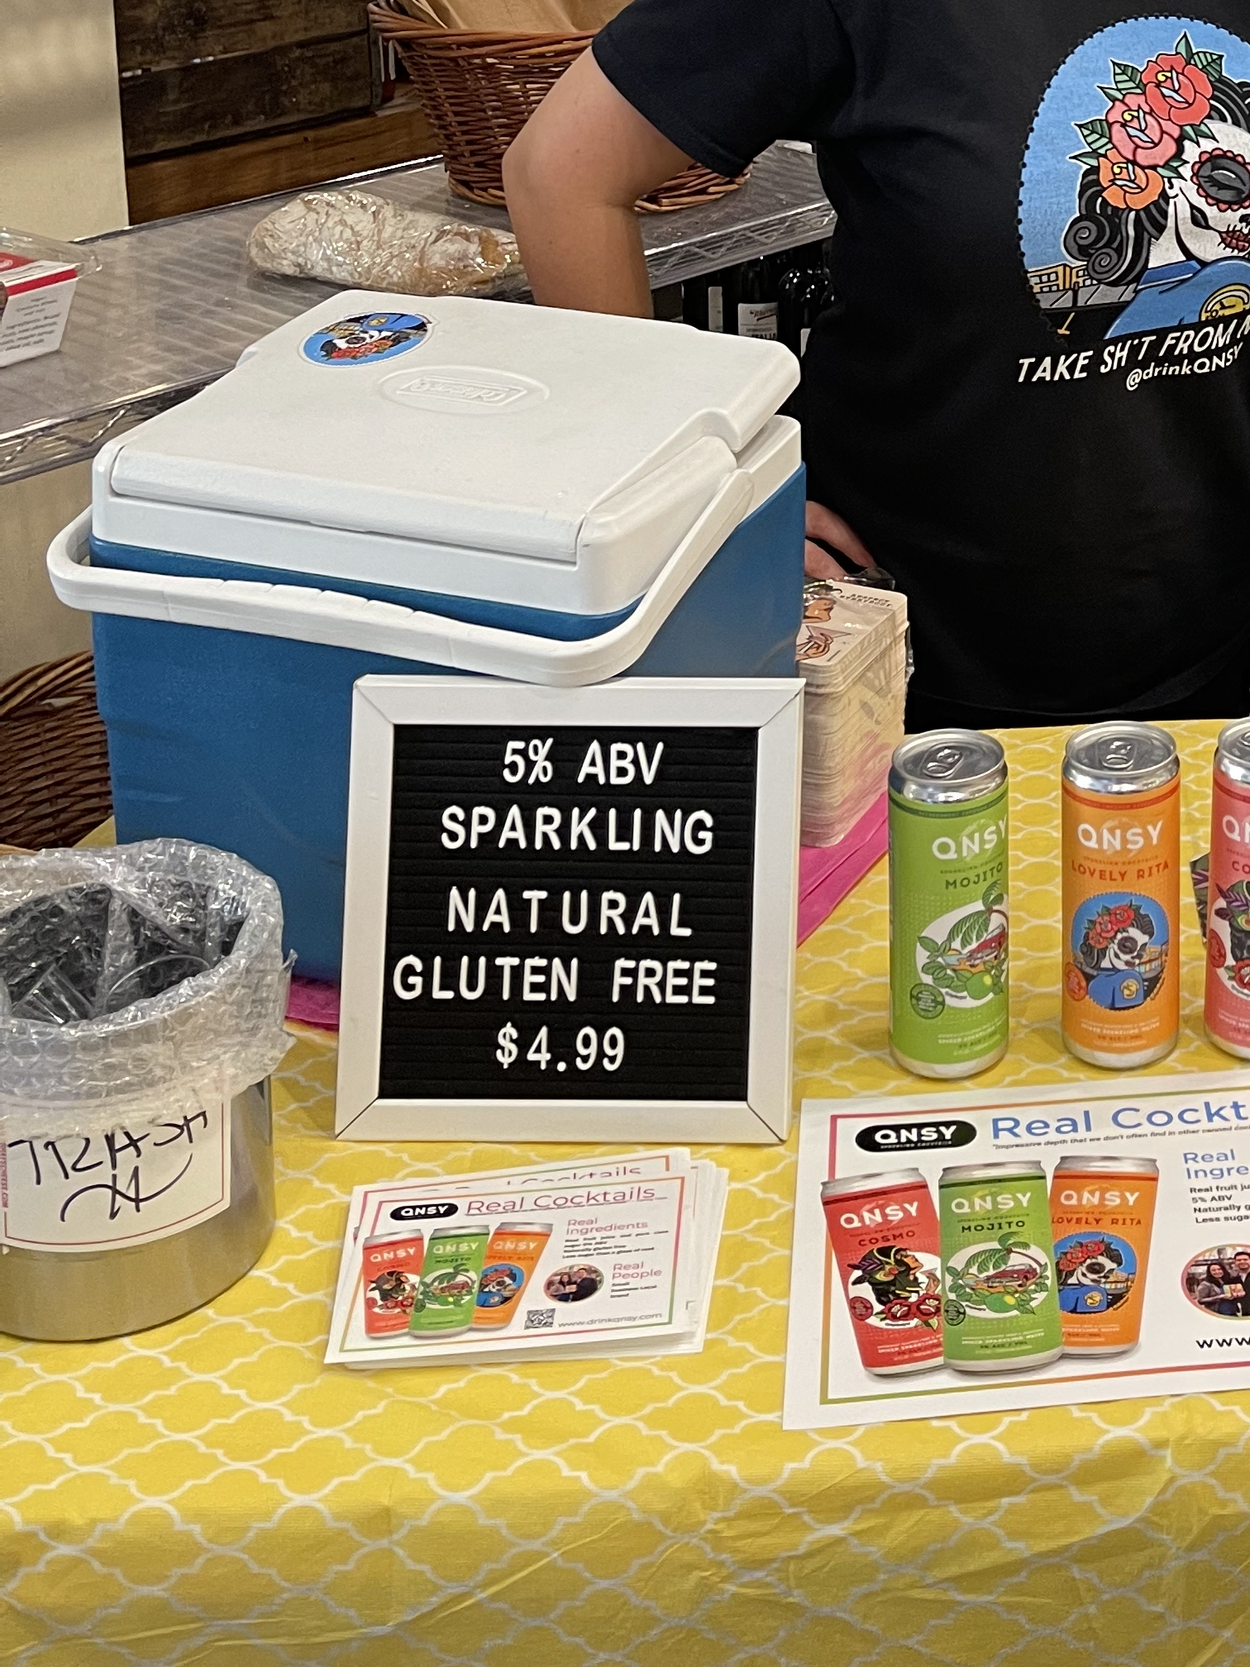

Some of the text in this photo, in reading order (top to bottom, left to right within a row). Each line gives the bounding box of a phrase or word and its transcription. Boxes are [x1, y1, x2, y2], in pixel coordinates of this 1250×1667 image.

[1018, 350, 1093, 383] TAKE
[1159, 319, 1238, 357] FROM
[1126, 342, 1243, 391] @drinkQNSY
[502, 738, 664, 785] 5% ABV
[440, 804, 714, 855] SPARKLING
[932, 814, 1007, 860] QNSY
[1077, 820, 1163, 851] QNSY
[945, 861, 1003, 890] MOJITO
[1071, 859, 1169, 882] LOVELY RITA
[448, 886, 692, 937] NATURAL
[393, 954, 718, 1005] GLUTEN FREE
[496, 1021, 625, 1072] $4.99
[991, 1108, 1093, 1140] Real
[874, 1125, 958, 1145] QNSY
[1044, 1138, 1068, 1147] depth
[1182, 1149, 1235, 1165] Real
[1060, 1189, 1141, 1206] QNSY
[1190, 1185, 1213, 1194] Real
[1216, 1184, 1238, 1192] fruit
[467, 1186, 655, 1215] Real Cocktails
[950, 1192, 1032, 1214] QNSY
[1210, 1194, 1233, 1202] ABV
[401, 1205, 449, 1217] QNSY
[840, 1202, 919, 1229] QNSY
[1193, 1204, 1242, 1214] Naturally
[566, 1221, 648, 1235] Ingredients
[567, 1217, 598, 1227] Real
[961, 1220, 1026, 1233] MOJITO
[1051, 1215, 1143, 1226] LOVELY RITA
[1195, 1216, 1221, 1224] Less
[493, 1240, 539, 1251] QNSY
[858, 1230, 916, 1247] COSMO
[370, 1247, 416, 1263] QNSY
[433, 1241, 480, 1254] QNSY
[612, 1269, 662, 1280] People
[613, 1261, 644, 1272] Real
